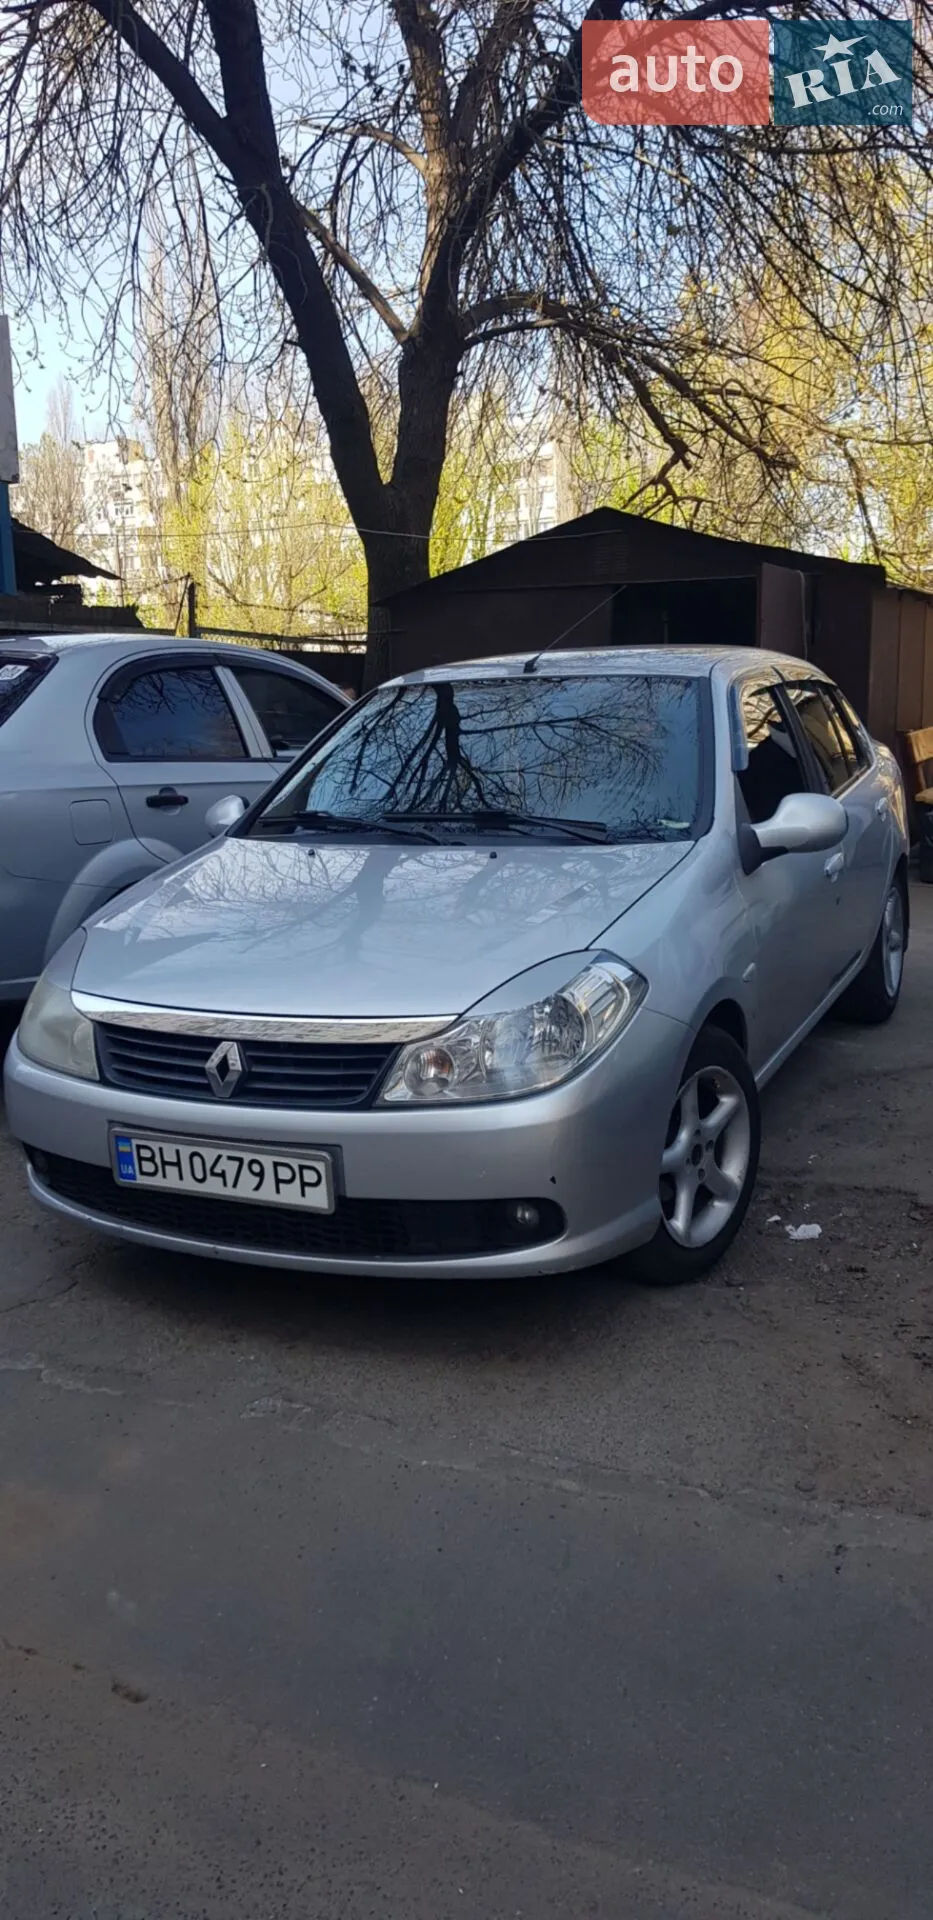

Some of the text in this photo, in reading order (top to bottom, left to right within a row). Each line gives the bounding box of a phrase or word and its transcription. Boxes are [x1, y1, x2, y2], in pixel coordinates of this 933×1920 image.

[120, 1162, 135, 1175] UA
[135, 1143, 323, 1198] BH 0479 PP
